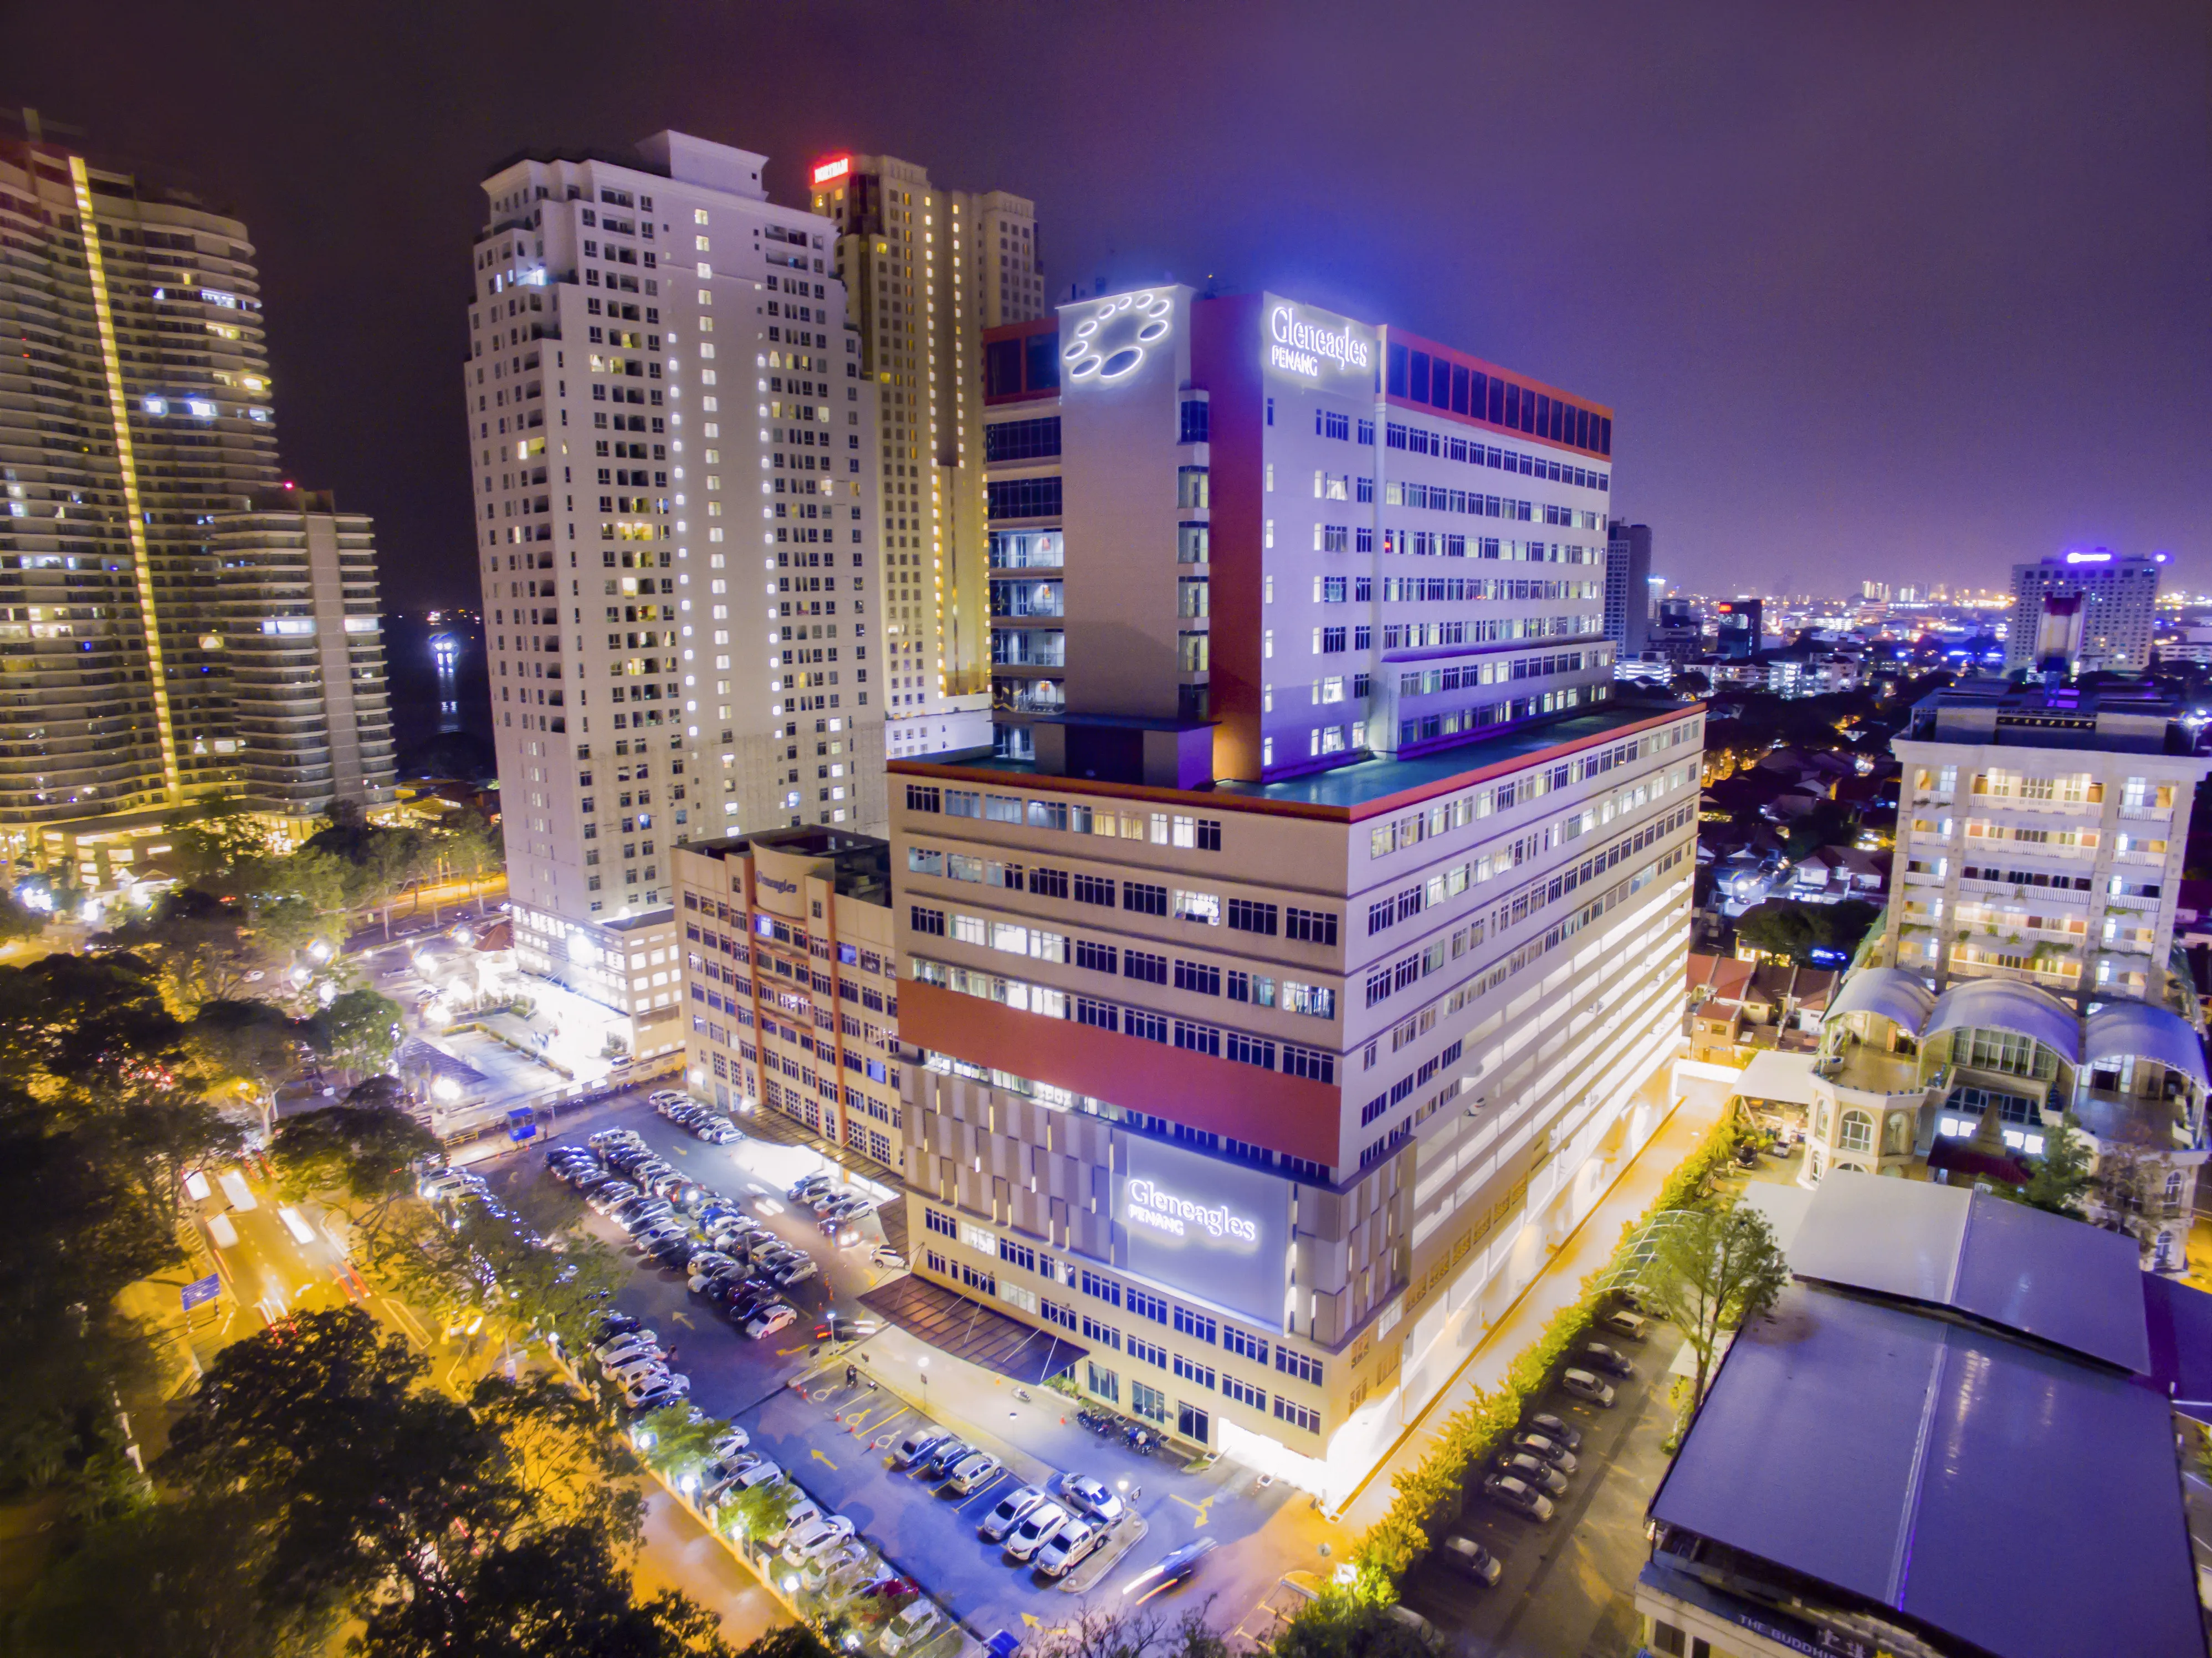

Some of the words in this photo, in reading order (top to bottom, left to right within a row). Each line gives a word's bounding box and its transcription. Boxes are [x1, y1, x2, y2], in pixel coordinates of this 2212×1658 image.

[1272, 306, 1368, 370] Gleneagles
[1272, 345, 1318, 376] PENANG
[1128, 1179, 1256, 1241] Gleneagles
[1128, 1204, 1184, 1236] PENANG
[1739, 1614, 1767, 1633] THE
